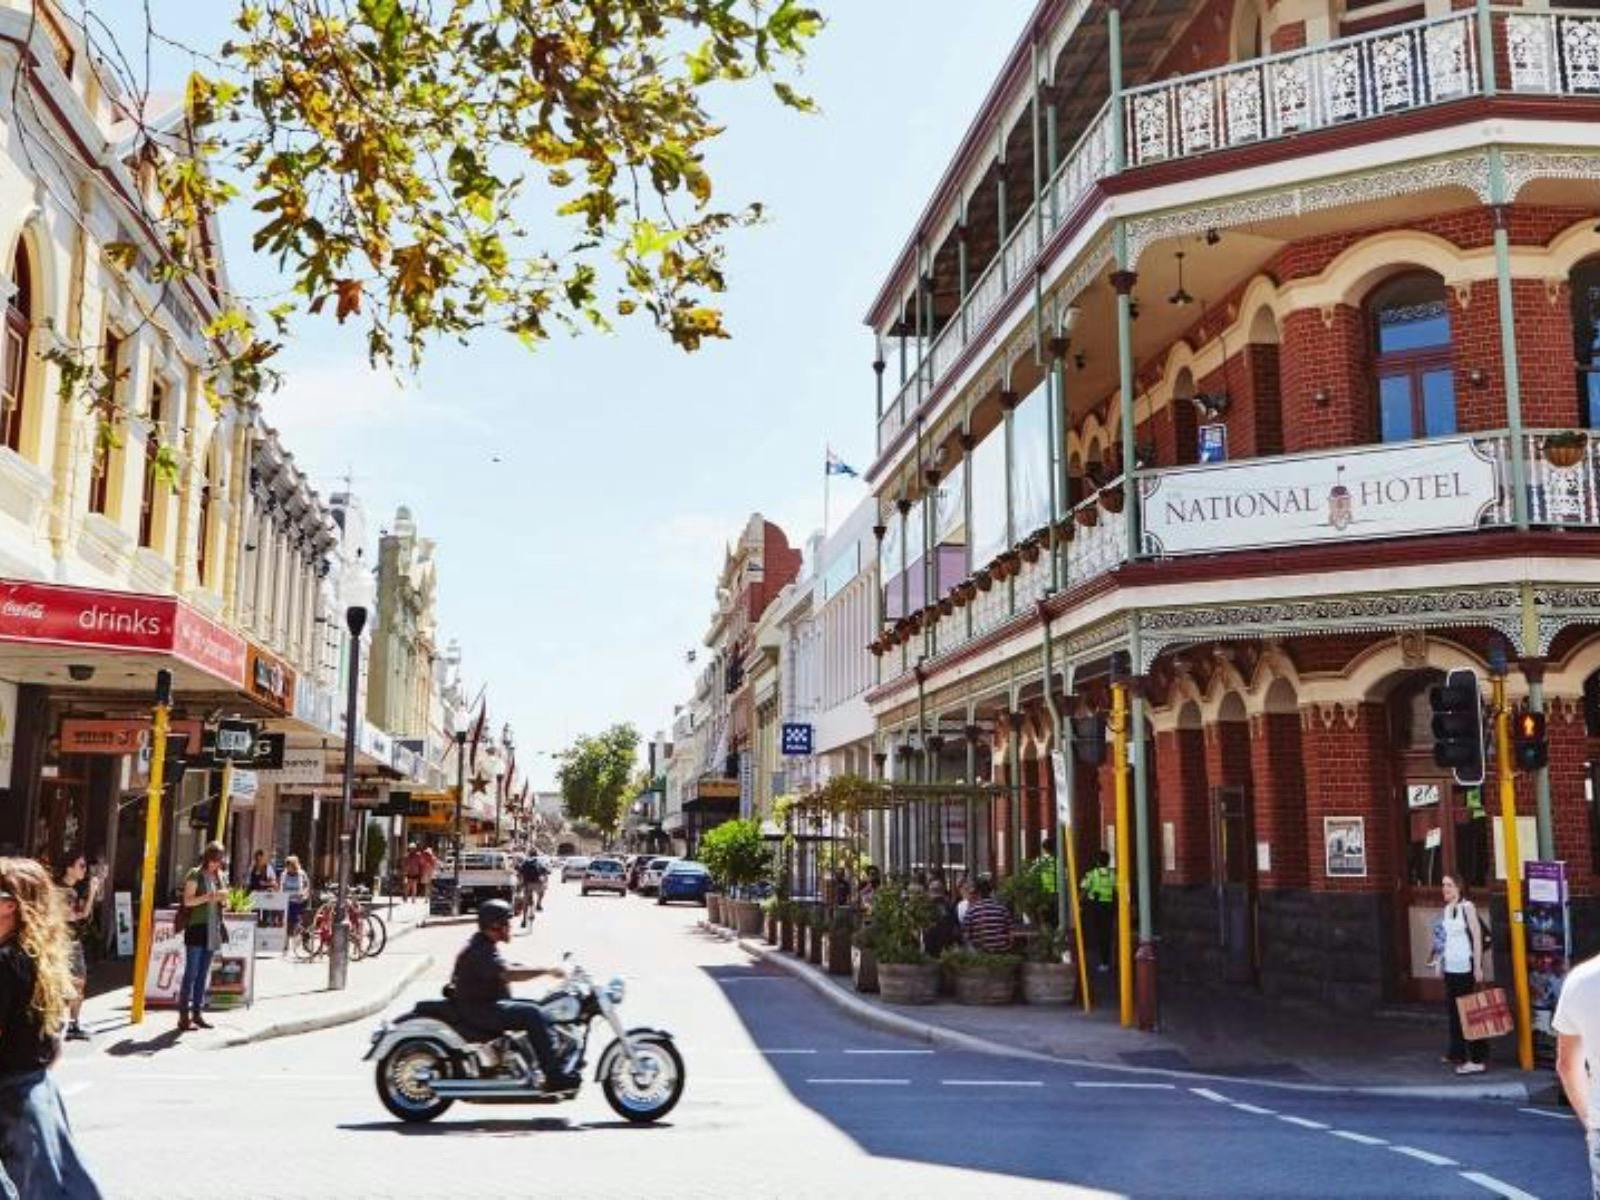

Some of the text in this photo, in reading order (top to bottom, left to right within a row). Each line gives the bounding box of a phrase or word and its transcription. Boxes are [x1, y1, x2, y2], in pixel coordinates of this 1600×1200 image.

[1165, 472, 1469, 525] NATIONAL HOTEL
[78, 605, 161, 635] drinks
